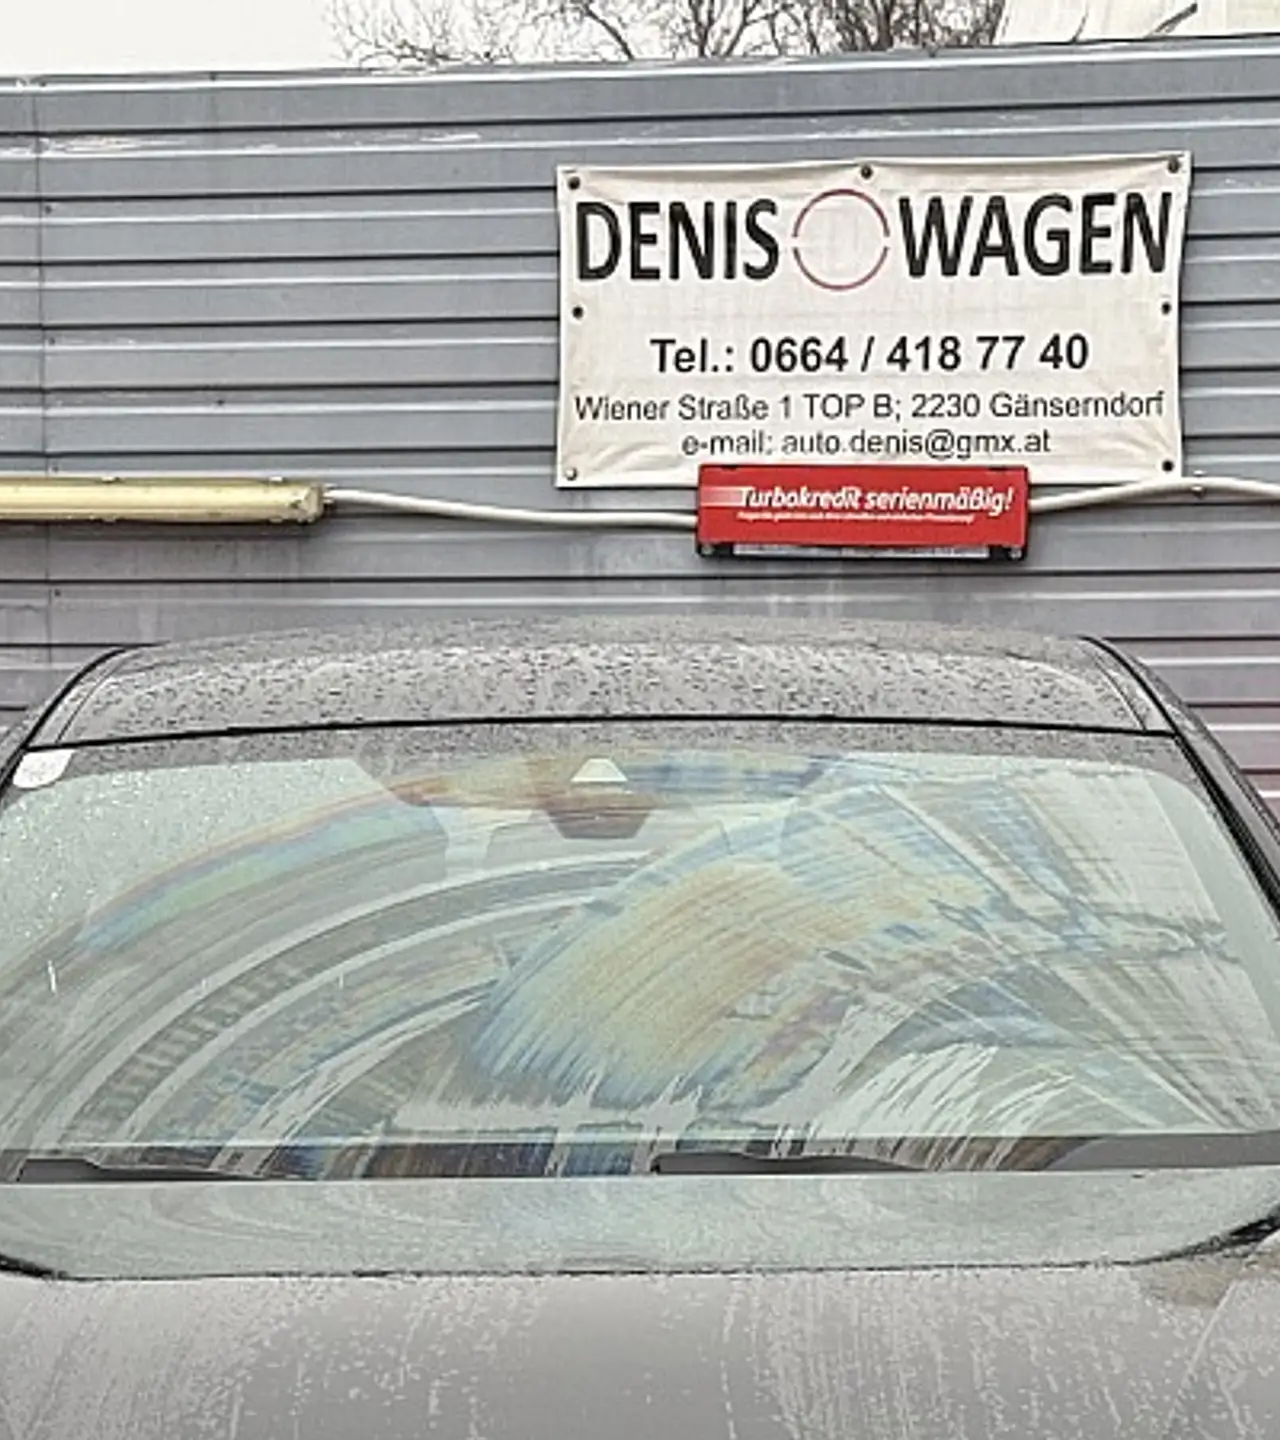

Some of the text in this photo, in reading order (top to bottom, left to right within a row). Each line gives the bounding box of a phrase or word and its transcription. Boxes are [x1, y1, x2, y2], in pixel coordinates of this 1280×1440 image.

[575, 191, 1173, 280] DENIS WAGEN
[650, 333, 1090, 374] Tel.: 0664 / 418 77 40
[575, 390, 1166, 422] Wiener Straße 1 TOP B; 2230 Gänserndorf
[681, 428, 1052, 459] e-mail: auto.denis@gmx.at
[739, 485, 1014, 517] Turbokredit serienmäßig!
